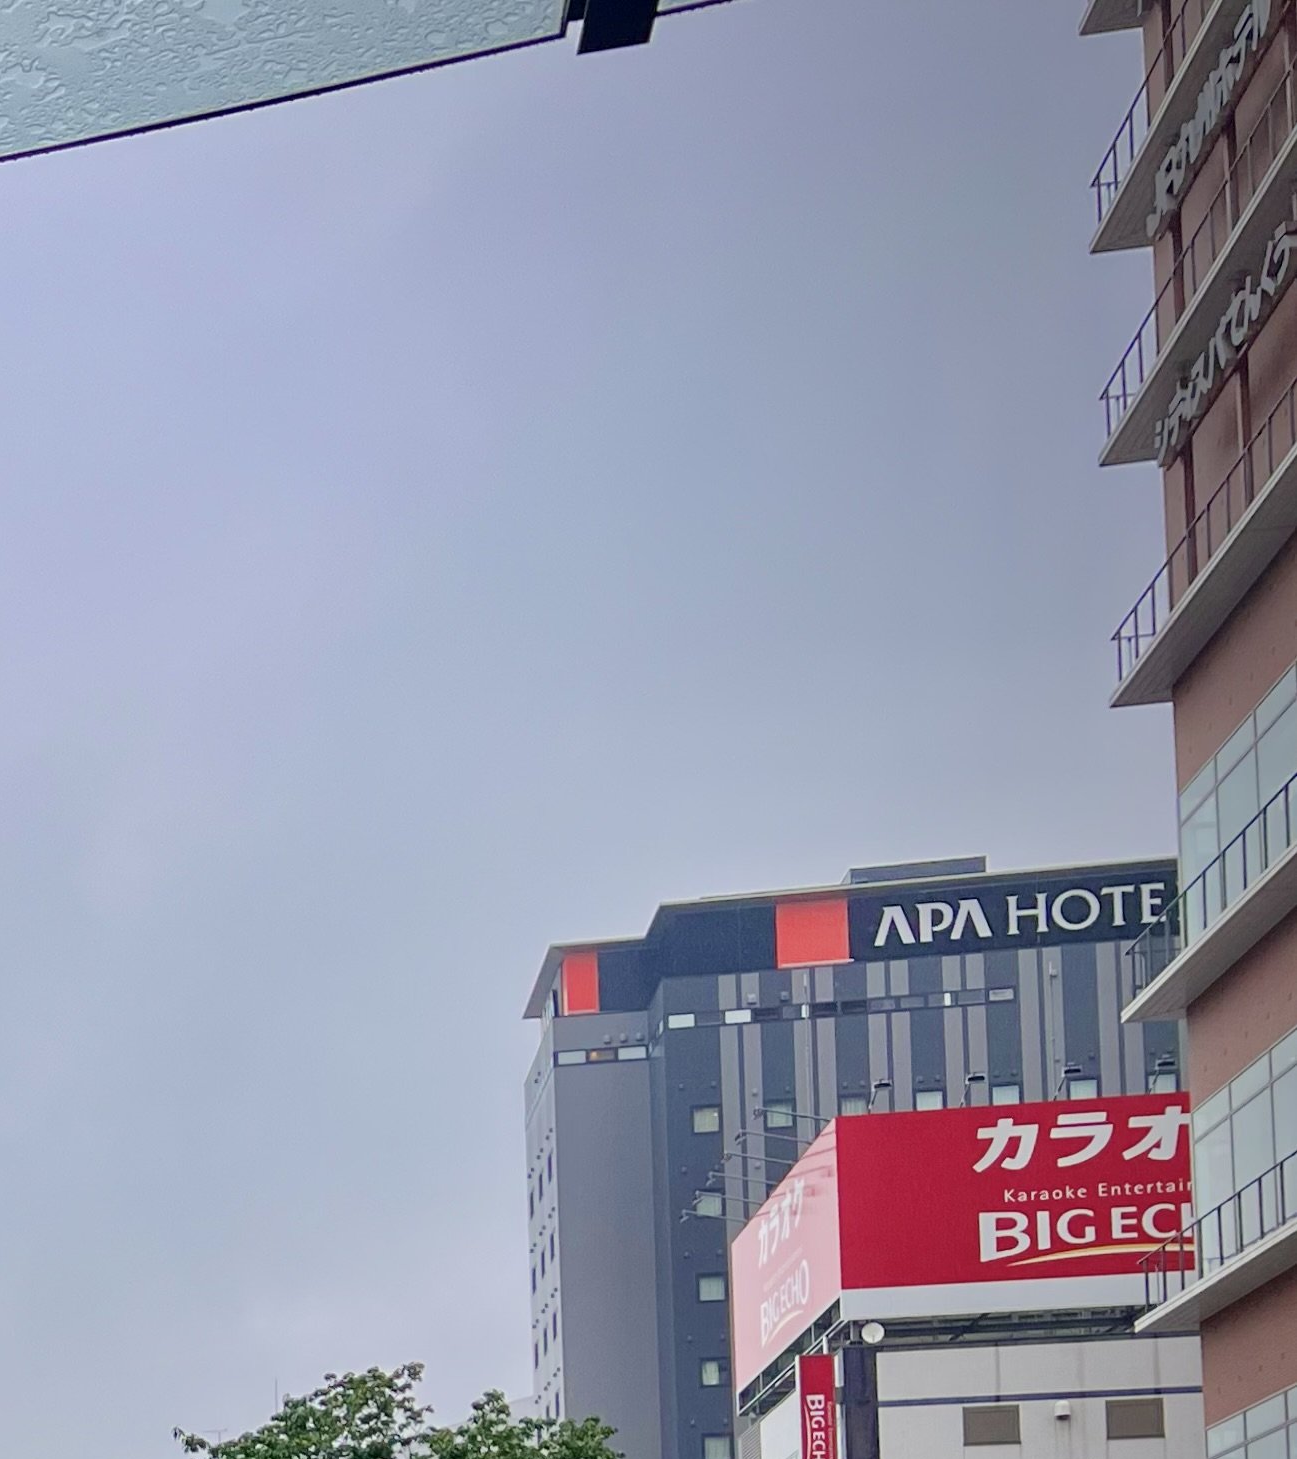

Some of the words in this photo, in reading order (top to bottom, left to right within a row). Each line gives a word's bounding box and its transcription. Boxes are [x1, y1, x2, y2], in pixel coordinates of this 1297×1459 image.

[873, 898, 993, 947] APA
[1007, 882, 1180, 936] HOTE
[758, 1178, 805, 1269] カラオケ
[1004, 1186, 1088, 1203] Karaoke
[978, 1208, 1097, 1263] BIG
[760, 1293, 780, 1347] BIG
[779, 1258, 810, 1313] ECHO
[806, 1394, 825, 1429] BIG
